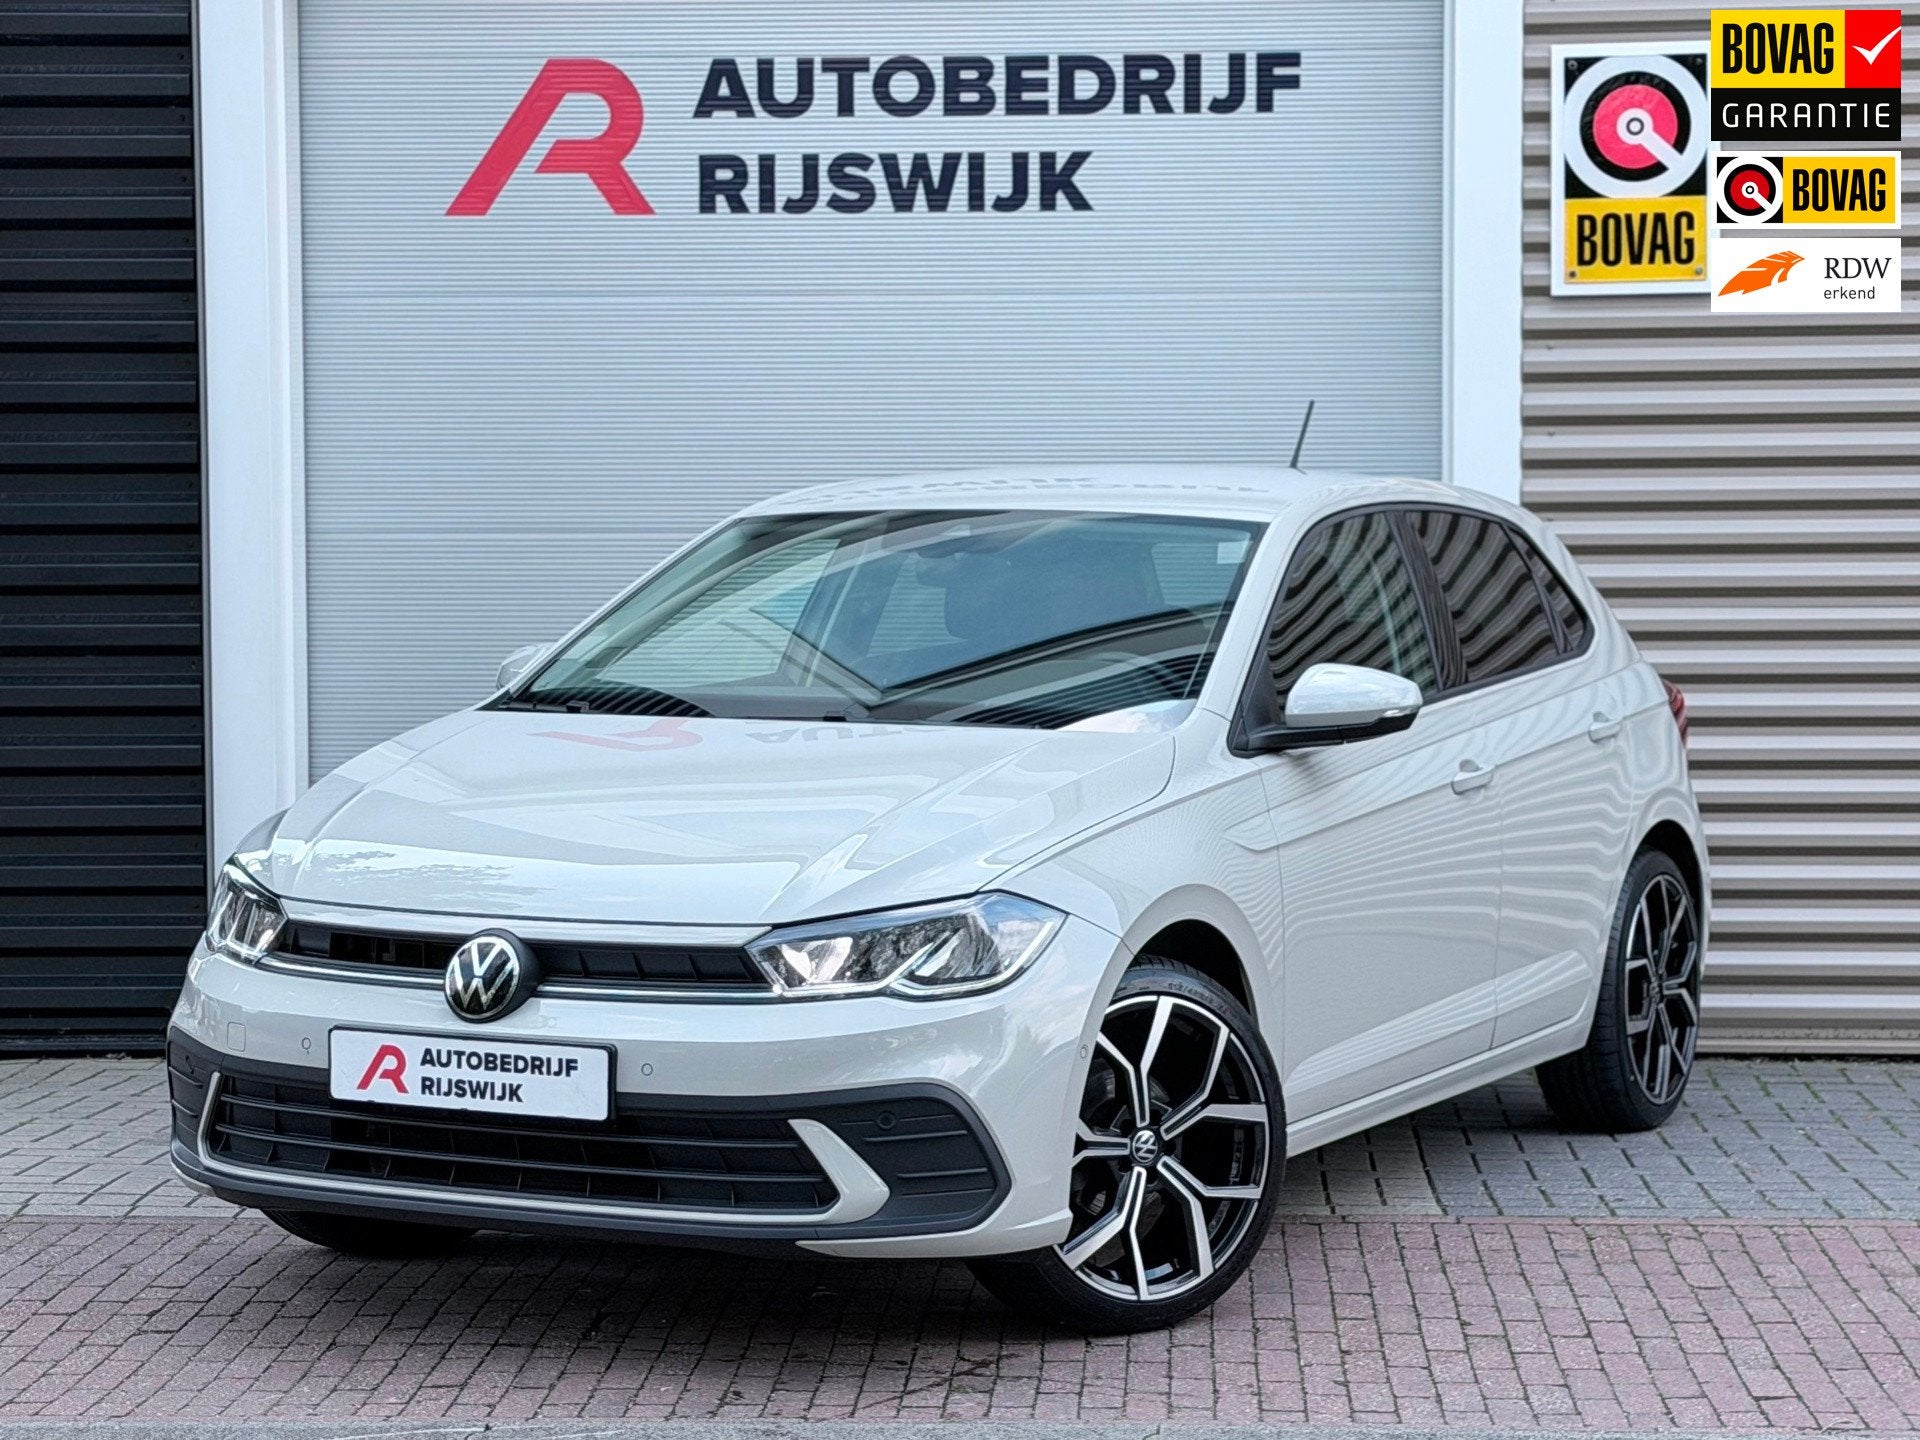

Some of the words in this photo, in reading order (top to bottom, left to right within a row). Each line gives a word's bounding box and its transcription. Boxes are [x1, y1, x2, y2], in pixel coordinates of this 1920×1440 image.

[693, 51, 1302, 119] AUTOBEDRIJF
[698, 151, 1094, 215] RIJSWIJK
[1576, 210, 1695, 267] BOVAG
[420, 1047, 579, 1078] AUTOBEDRIJF
[420, 1076, 524, 1103] RIJSWIJK
